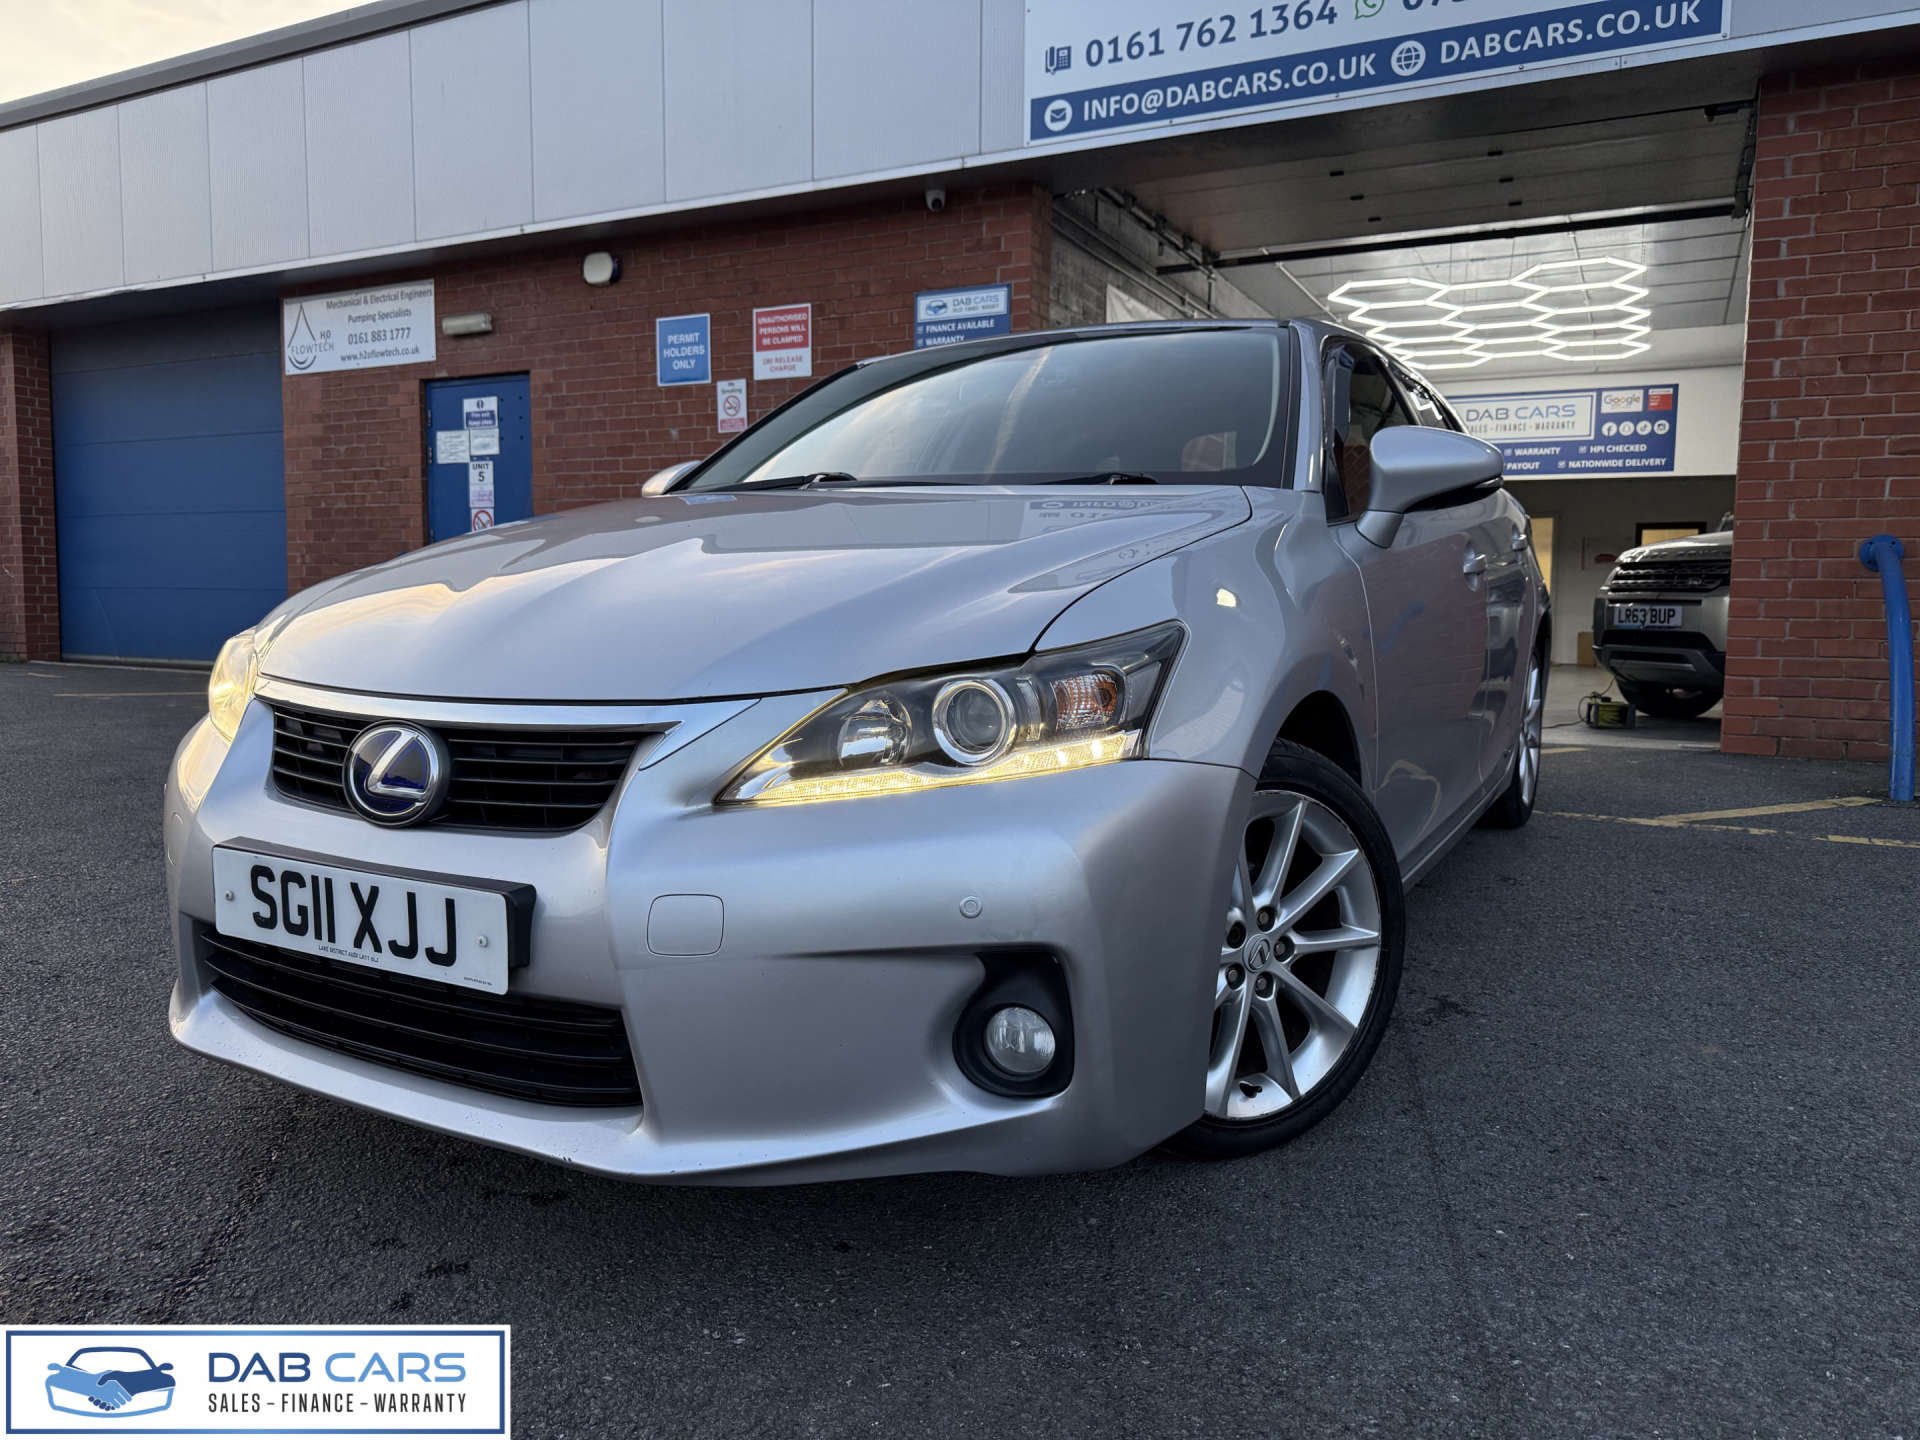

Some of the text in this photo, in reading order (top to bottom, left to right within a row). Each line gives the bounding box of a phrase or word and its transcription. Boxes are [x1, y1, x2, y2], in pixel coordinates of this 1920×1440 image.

[1085, 0, 1337, 67] 0161 762 1364
[1441, 0, 1700, 64] DABCARS.CO.UK
[1083, 53, 1376, 121] INFO@DABCARS.CO.UK
[326, 297, 361, 309] Mechanical
[370, 291, 399, 304] Electrical
[400, 288, 433, 301] Engineers
[348, 308, 412, 323] Pumping Specialists
[791, 324, 806, 332] WILL
[926, 319, 995, 333] FINANCE AVAILABLE
[348, 332, 369, 345] 0161
[390, 327, 411, 339] 1777
[667, 333, 700, 344] PERMIT
[926, 335, 965, 346] WARRANTY
[291, 343, 334, 355] FLOWTECH
[663, 345, 705, 358] HOLDERS
[672, 359, 696, 370] ONLY
[1604, 394, 1640, 406] Google
[1466, 404, 1576, 422] DAB CARS
[1495, 422, 1527, 433] FINANCE
[1535, 420, 1576, 431] WARRANTY
[1514, 447, 1560, 456] WARRANTY
[1590, 444, 1647, 453] HPI CHECKED
[1506, 461, 1540, 470] PAYOUT
[1568, 458, 1666, 468] NATIONWIDE DELIVERY
[478, 471, 485, 482] 5
[1618, 608, 1676, 625] LR63 BUP
[251, 864, 457, 967] SG11 XJJ
